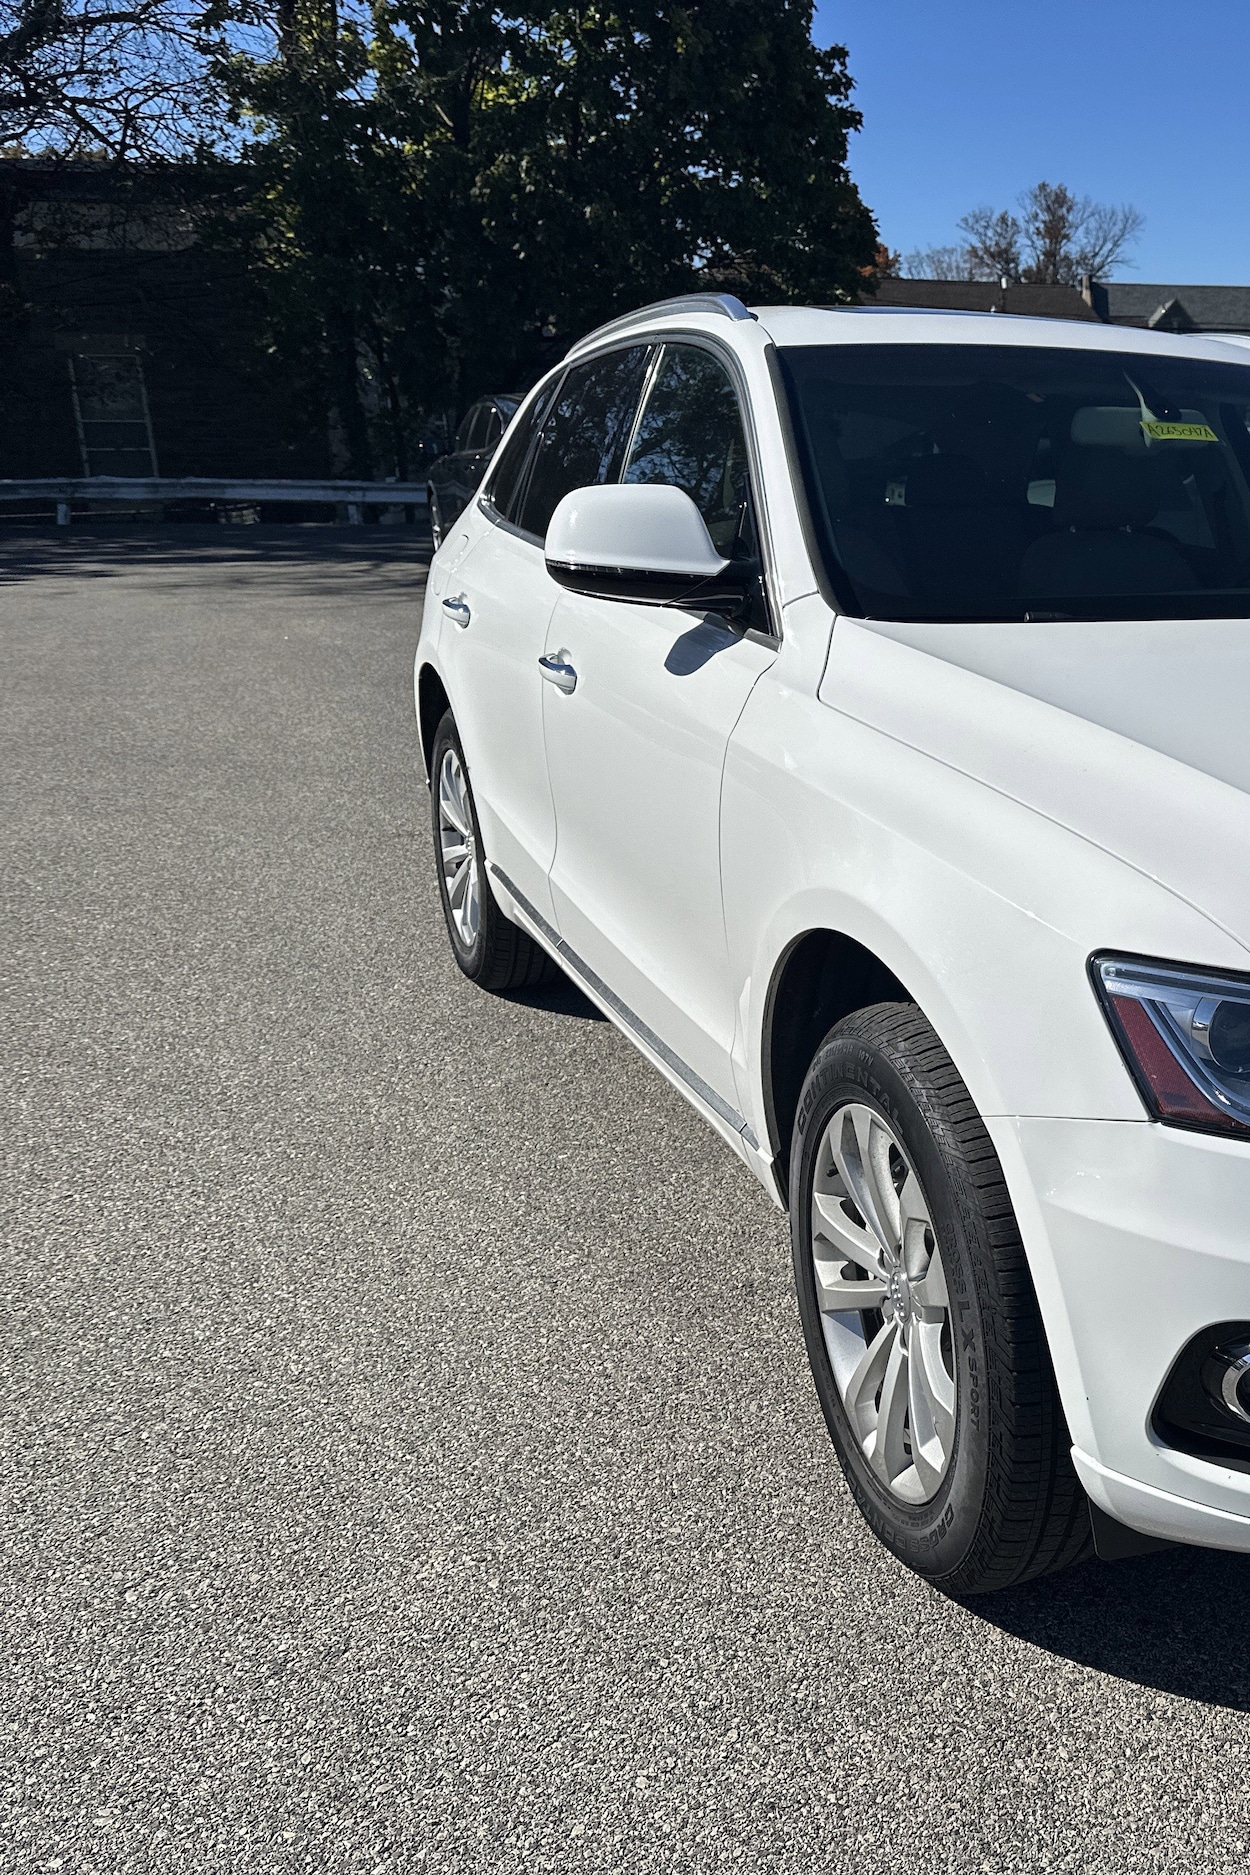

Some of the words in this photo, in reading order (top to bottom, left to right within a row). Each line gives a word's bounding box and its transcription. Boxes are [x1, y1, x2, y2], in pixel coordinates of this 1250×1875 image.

[798, 1061, 904, 1136] CONTINENTAL
[967, 1355, 980, 1432] SPORT
[909, 1502, 955, 1553] CROSS
